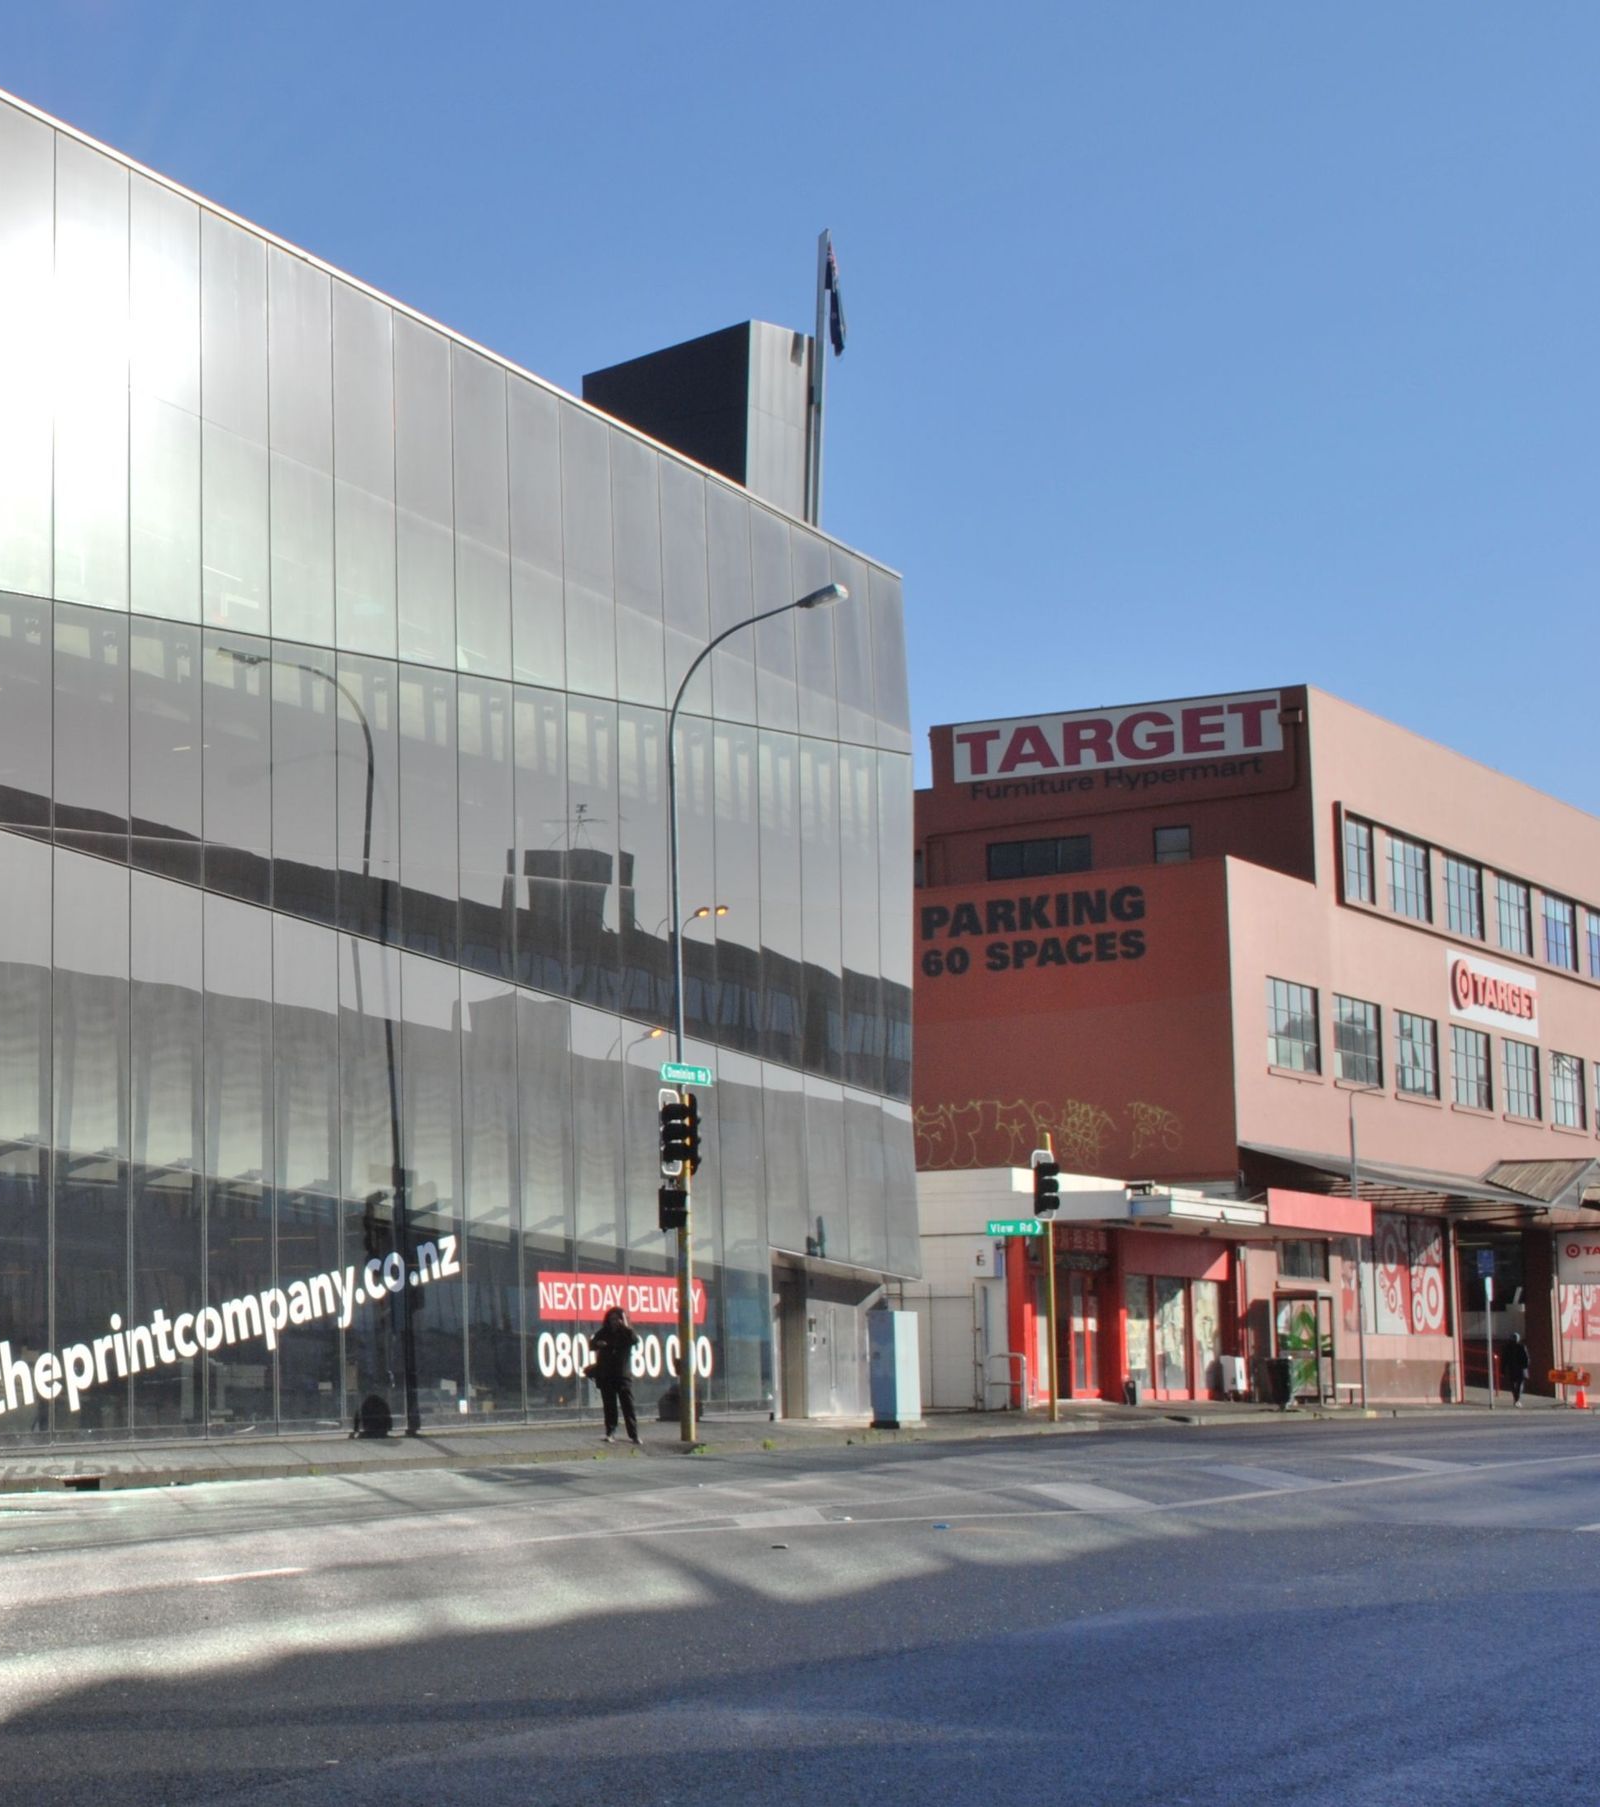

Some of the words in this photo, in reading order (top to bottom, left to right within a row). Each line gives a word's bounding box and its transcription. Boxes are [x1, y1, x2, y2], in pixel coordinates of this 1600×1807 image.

[955, 699, 1278, 776] TARGET
[970, 773, 1094, 800] Furniture
[1104, 756, 1264, 791] Hypermart
[921, 885, 1146, 940] PARKING
[921, 947, 970, 977] 60
[986, 929, 1147, 972] SPACES
[990, 1223, 1015, 1233] View
[1019, 1223, 1033, 1233] Rd
[538, 1281, 586, 1310] NEXT
[590, 1284, 624, 1311] DAY
[628, 1285, 701, 1314] DELIVEY
[538, 1332, 597, 1378] 080
